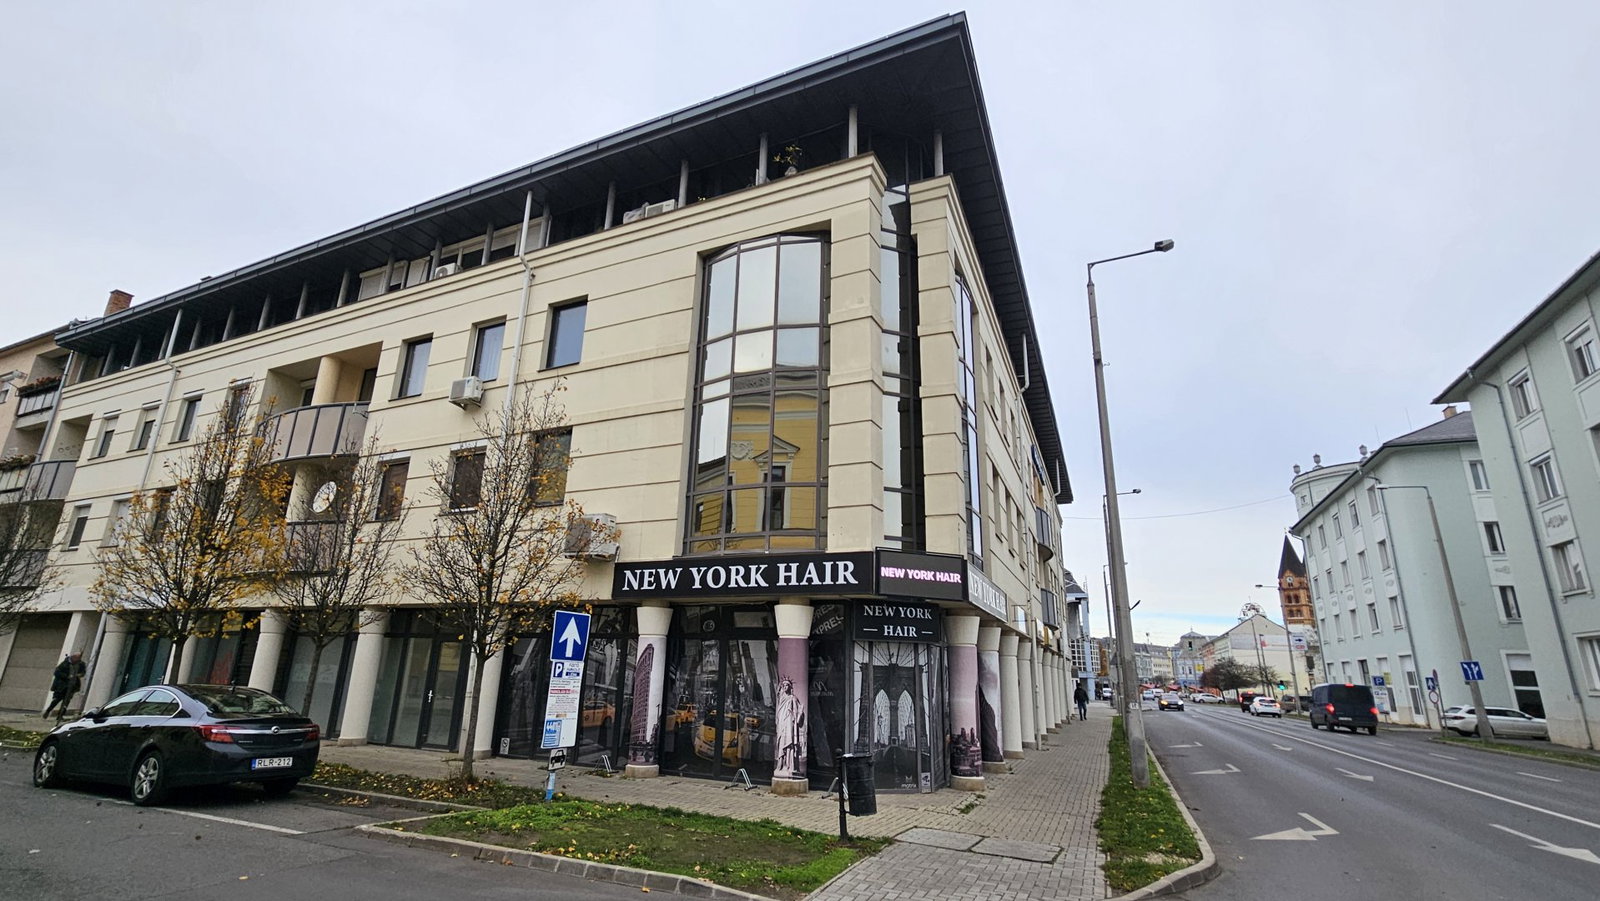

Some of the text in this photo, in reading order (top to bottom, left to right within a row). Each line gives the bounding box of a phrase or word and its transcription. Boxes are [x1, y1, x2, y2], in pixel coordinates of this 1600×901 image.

[621, 560, 858, 591] NEW YORK HAIR
[880, 566, 962, 583] NEW YORK HAIR
[863, 604, 932, 620] NEW YORK
[883, 624, 917, 637] HAIR
[555, 662, 563, 677] P
[257, 757, 291, 767] RLR-212
